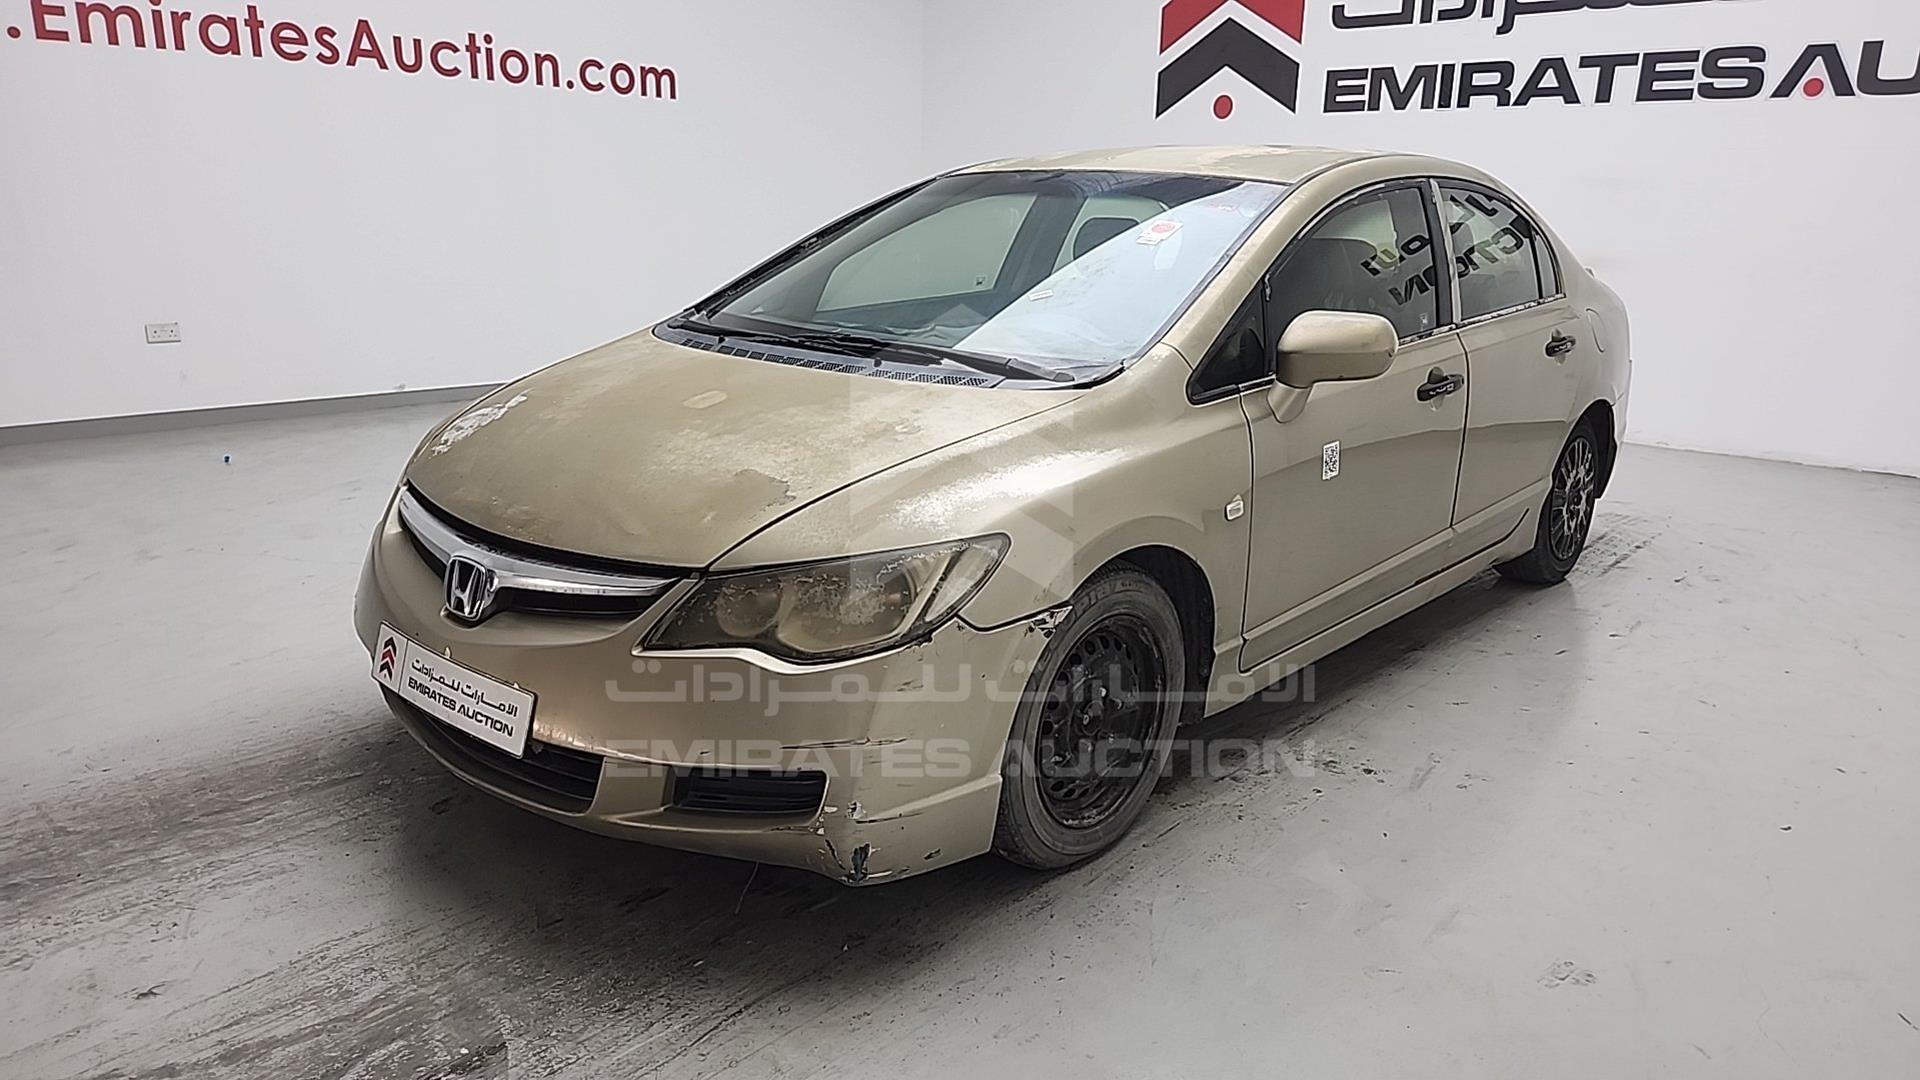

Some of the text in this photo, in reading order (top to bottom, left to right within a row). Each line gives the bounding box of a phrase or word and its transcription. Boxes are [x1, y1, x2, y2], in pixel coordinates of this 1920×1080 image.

[1323, 46, 1766, 113] EMIRATES
[407, 676, 514, 738] EMIRATES AUCTION
